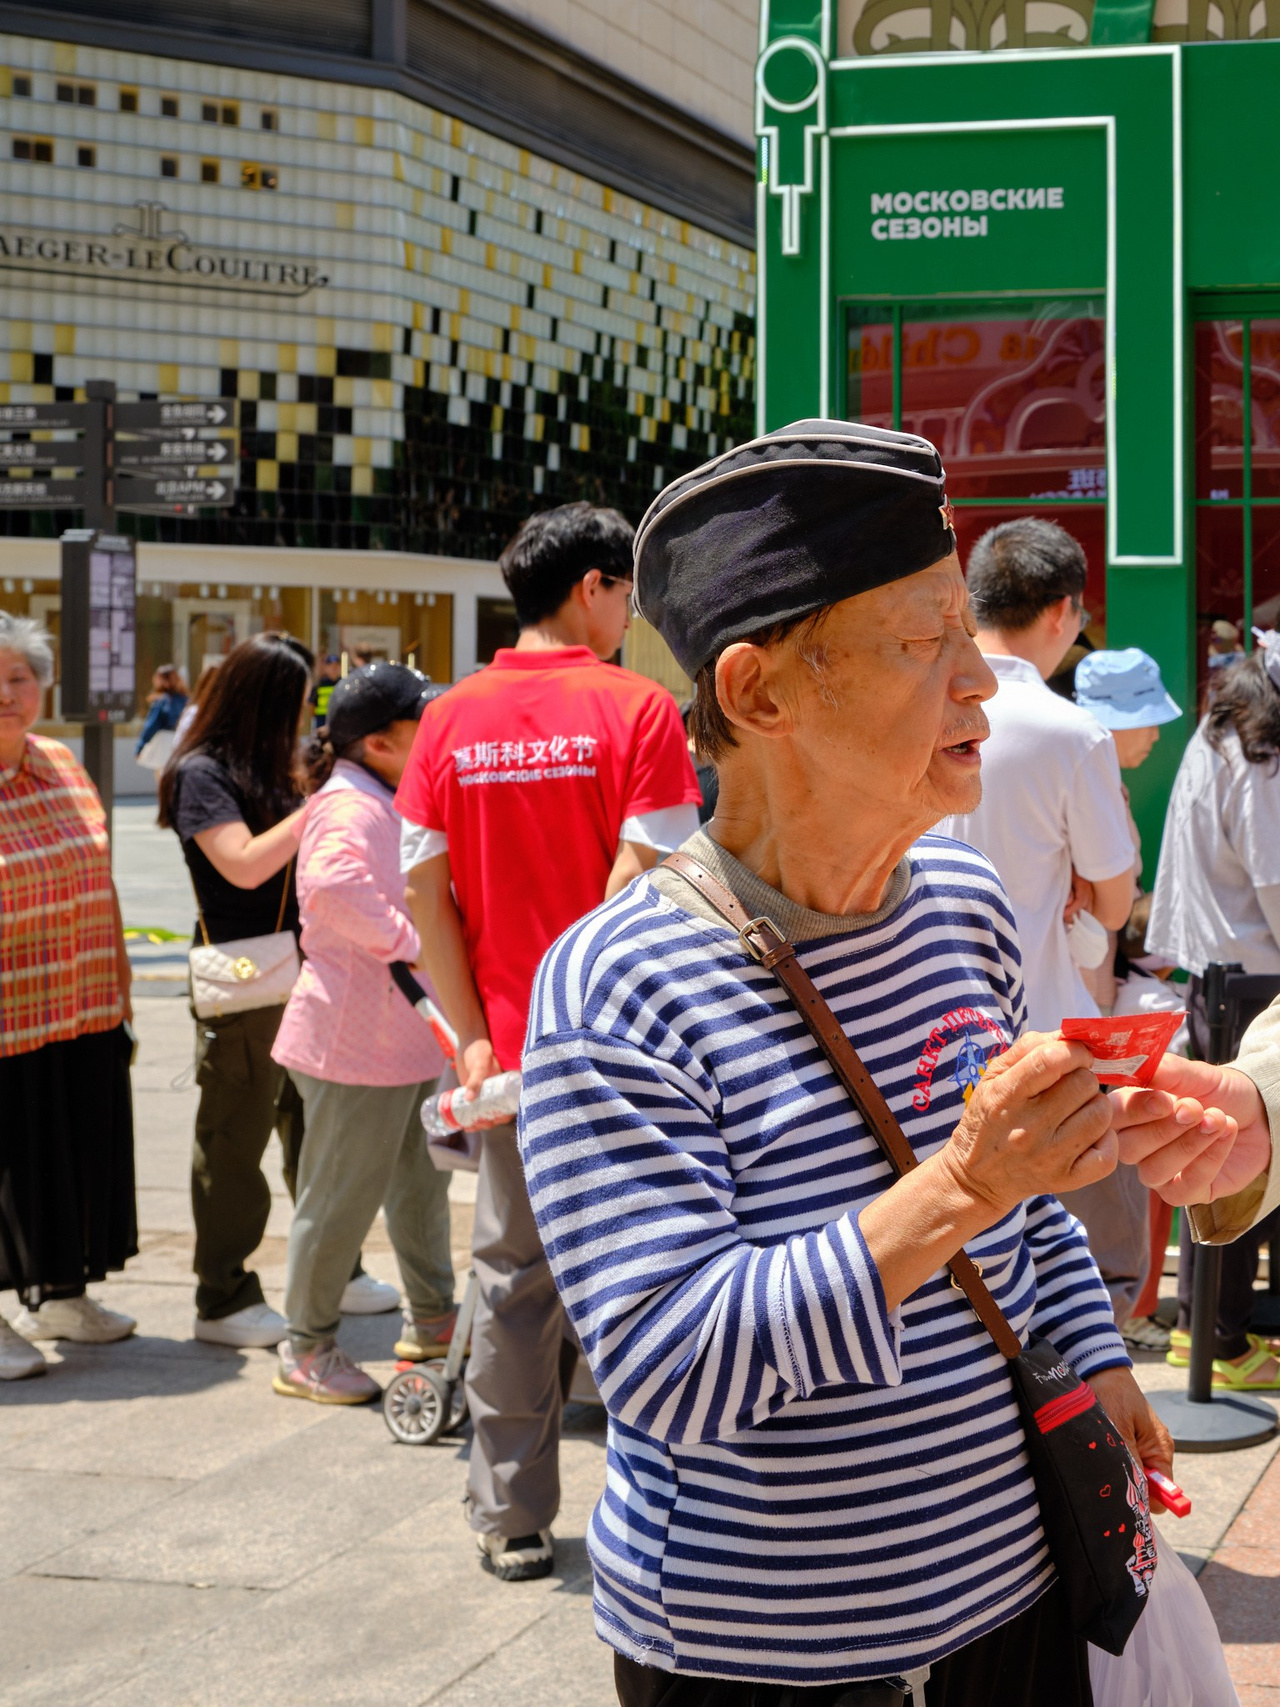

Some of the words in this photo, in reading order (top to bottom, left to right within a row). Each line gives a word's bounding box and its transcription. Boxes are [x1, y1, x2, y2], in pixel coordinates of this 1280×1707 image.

[870, 187, 1065, 215] МОСКОВСКИЕ
[870, 215, 988, 241] СЕЗОНЫ
[452, 735, 598, 773] 莫斯科文化节
[543, 765, 597, 780] СЕЗОНЫ
